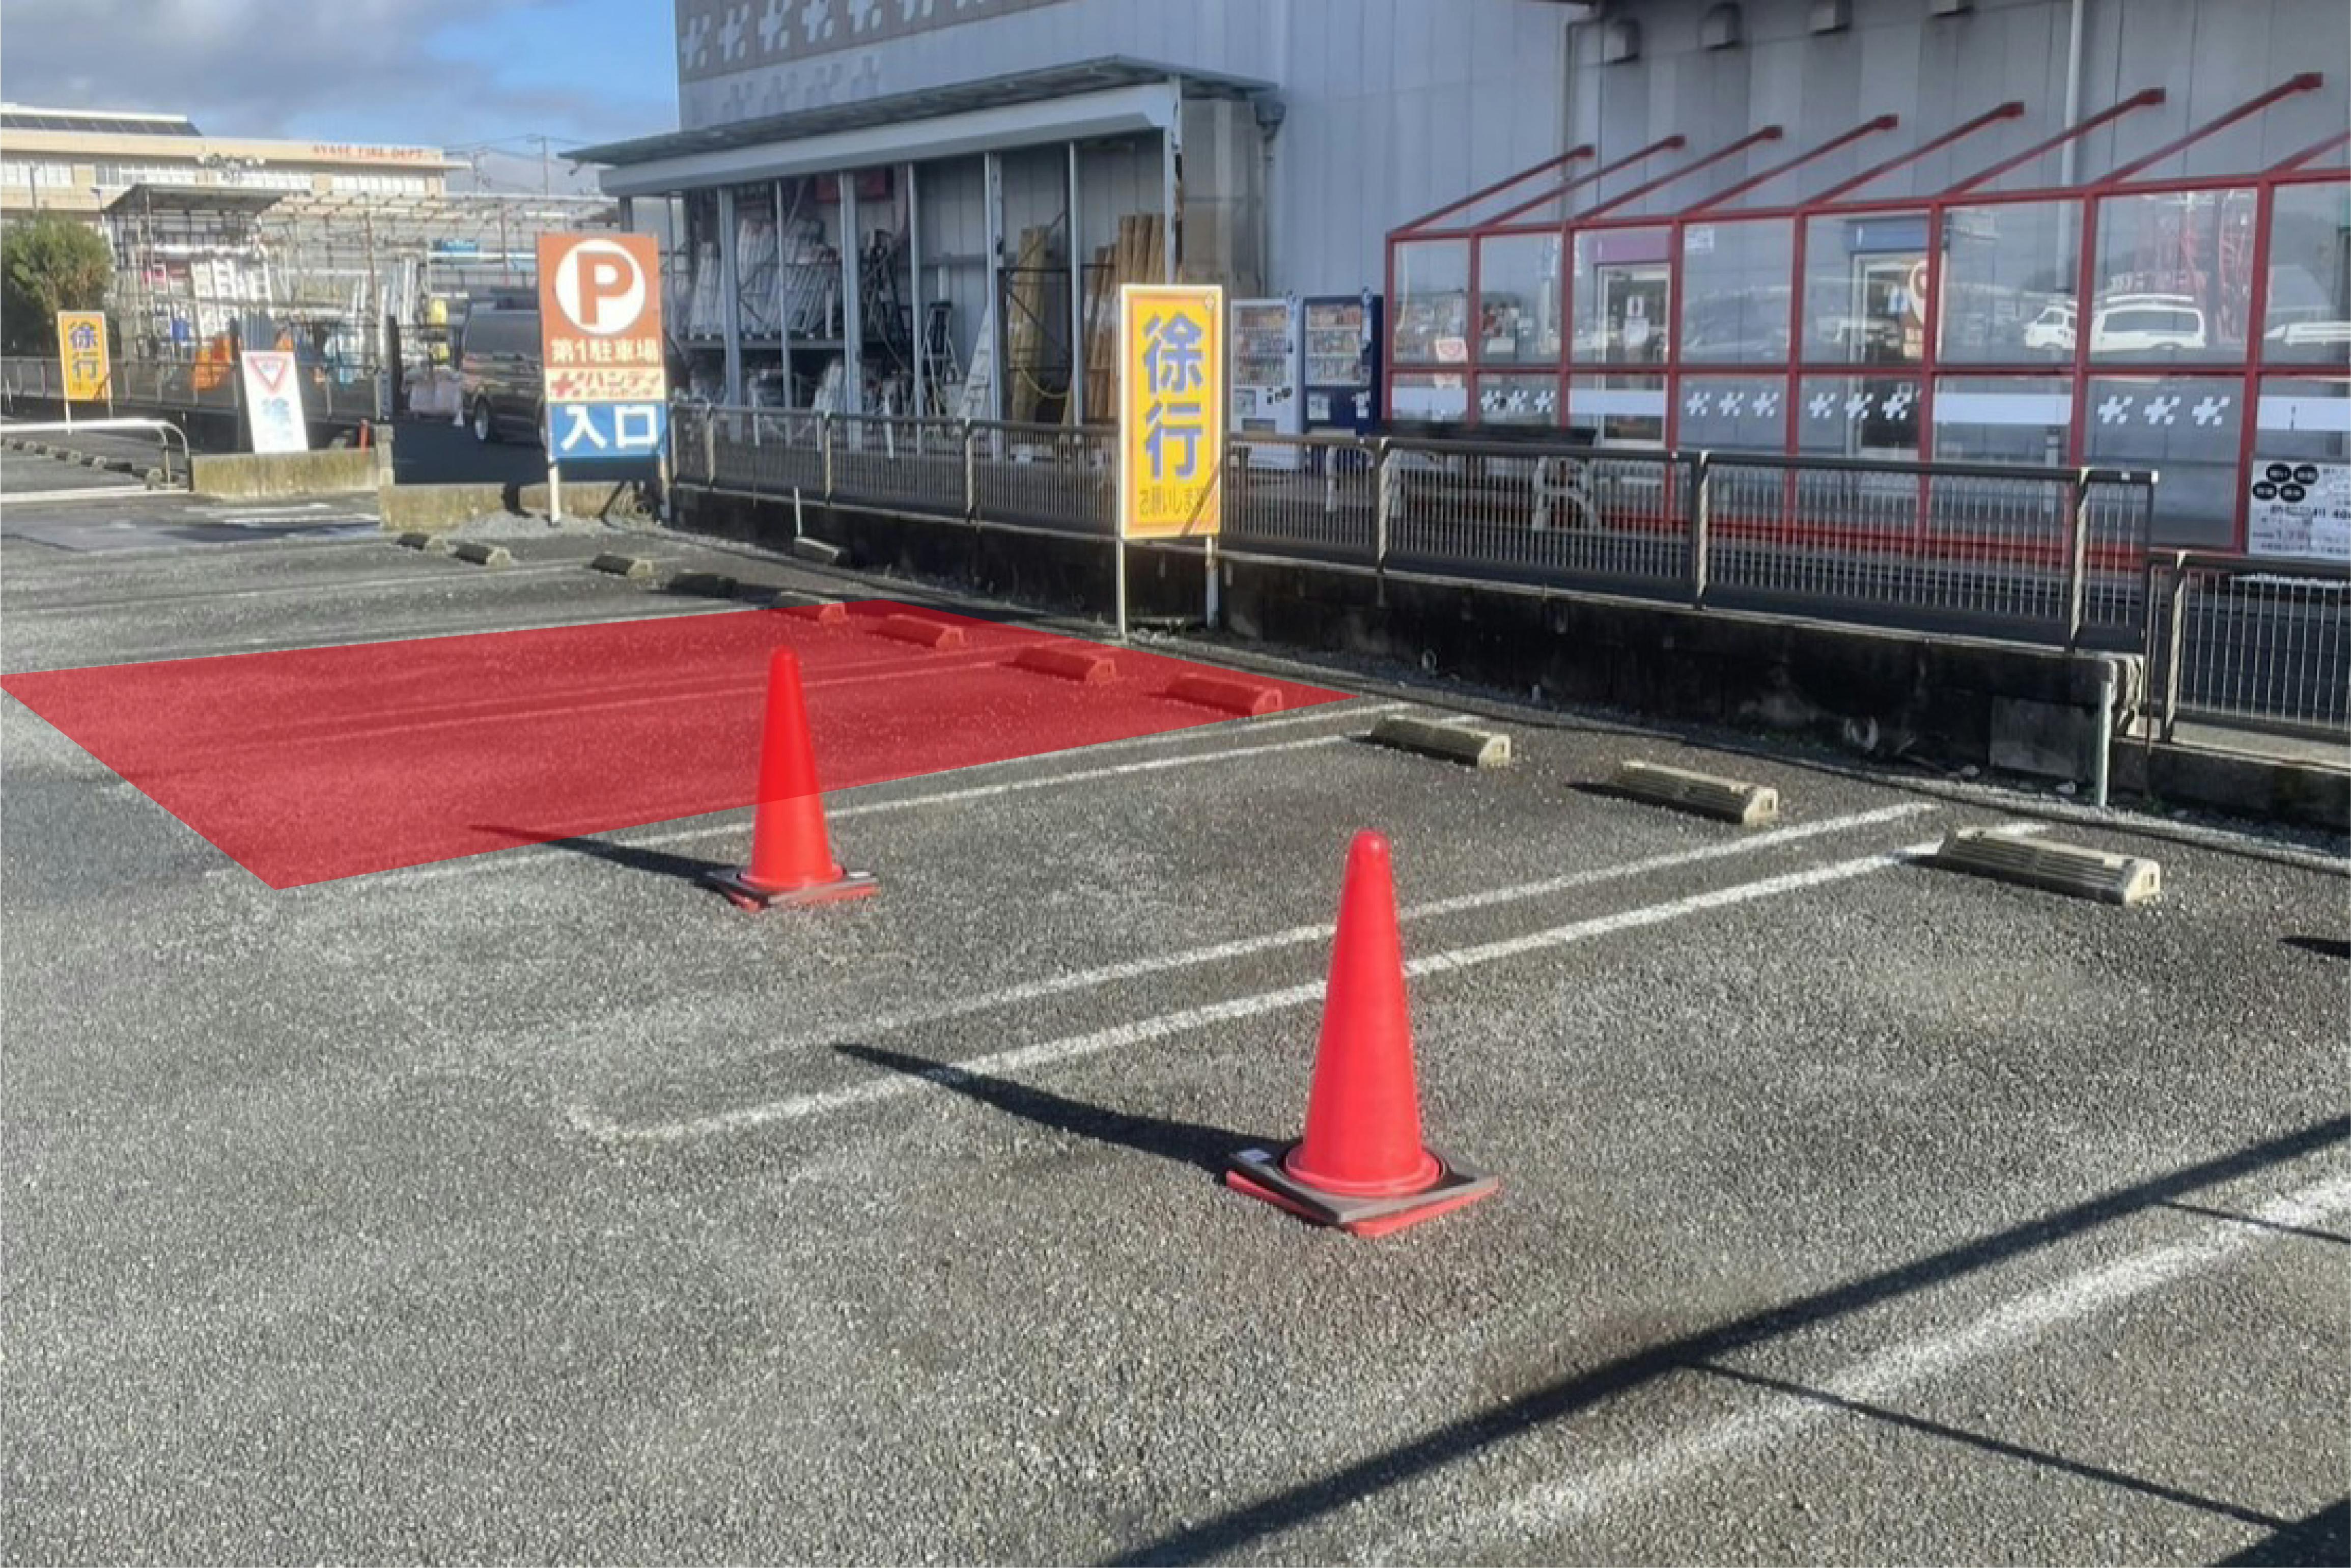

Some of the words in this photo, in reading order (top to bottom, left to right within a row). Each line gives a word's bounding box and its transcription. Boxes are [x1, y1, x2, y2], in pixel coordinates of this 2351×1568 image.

[578, 251, 635, 324] P
[68, 321, 99, 378] 徐行
[561, 405, 656, 450] 入口
[1142, 311, 1203, 480] 徐行
